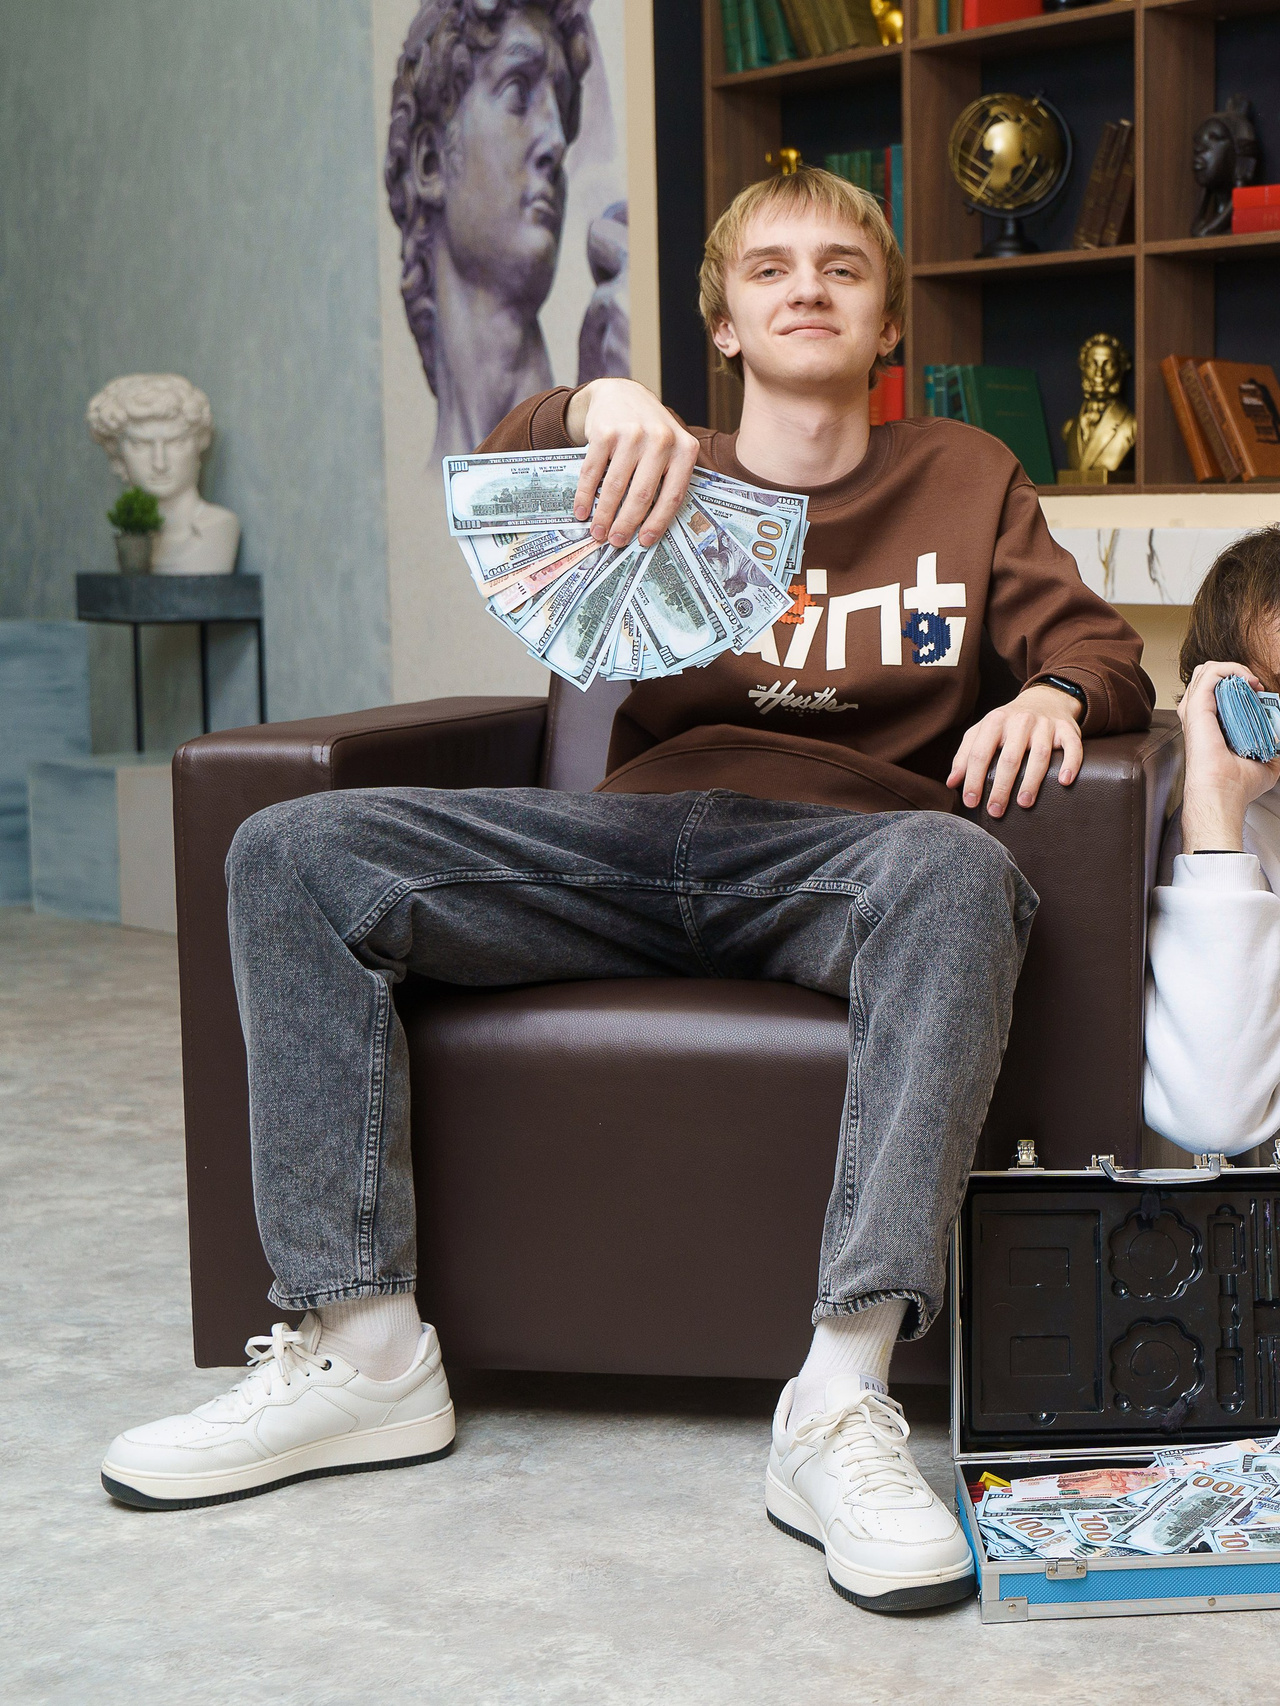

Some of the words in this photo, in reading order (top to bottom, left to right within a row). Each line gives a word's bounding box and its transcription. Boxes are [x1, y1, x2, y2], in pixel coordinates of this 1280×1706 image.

[450, 461, 469, 472] 100
[1192, 1475, 1246, 1497] 100
[1007, 1517, 1055, 1539] 100
[1077, 1514, 1113, 1541] 100
[1218, 1531, 1250, 1553] 10
